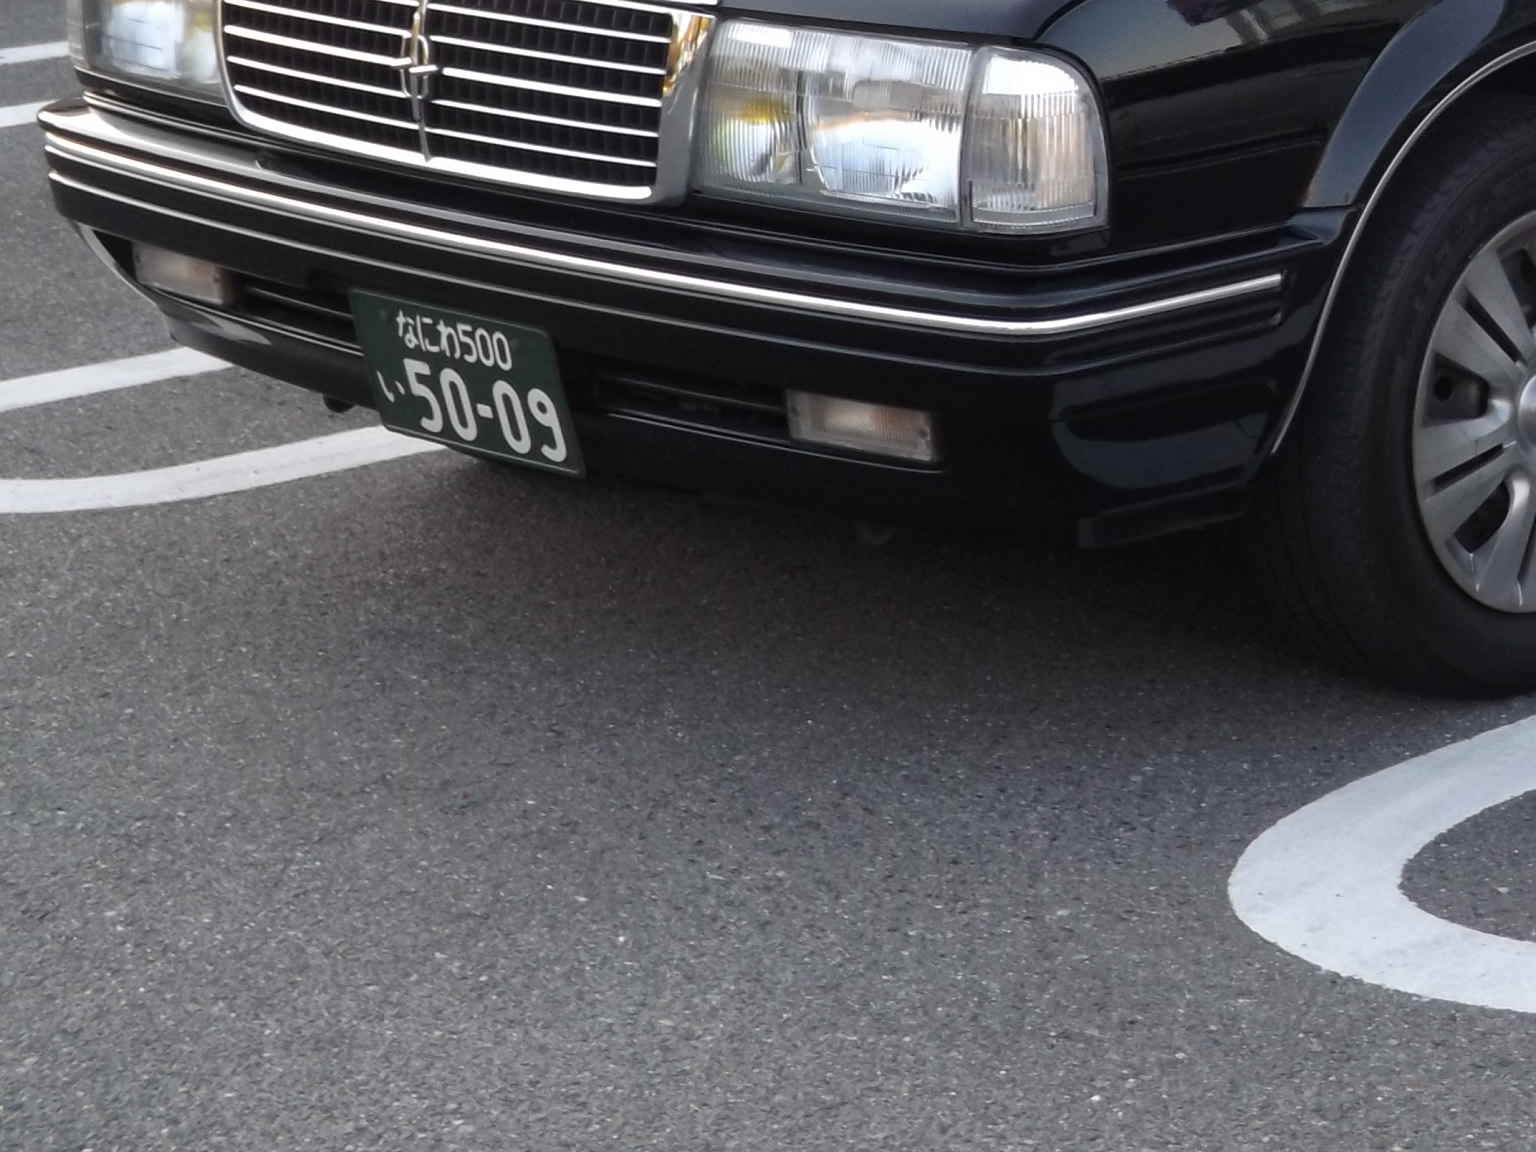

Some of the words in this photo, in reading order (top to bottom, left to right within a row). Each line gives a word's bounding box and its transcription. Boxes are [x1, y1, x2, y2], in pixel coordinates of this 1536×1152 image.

[395, 310, 514, 371] なにわ500
[377, 370, 406, 403] い
[403, 359, 567, 463] 50-09
